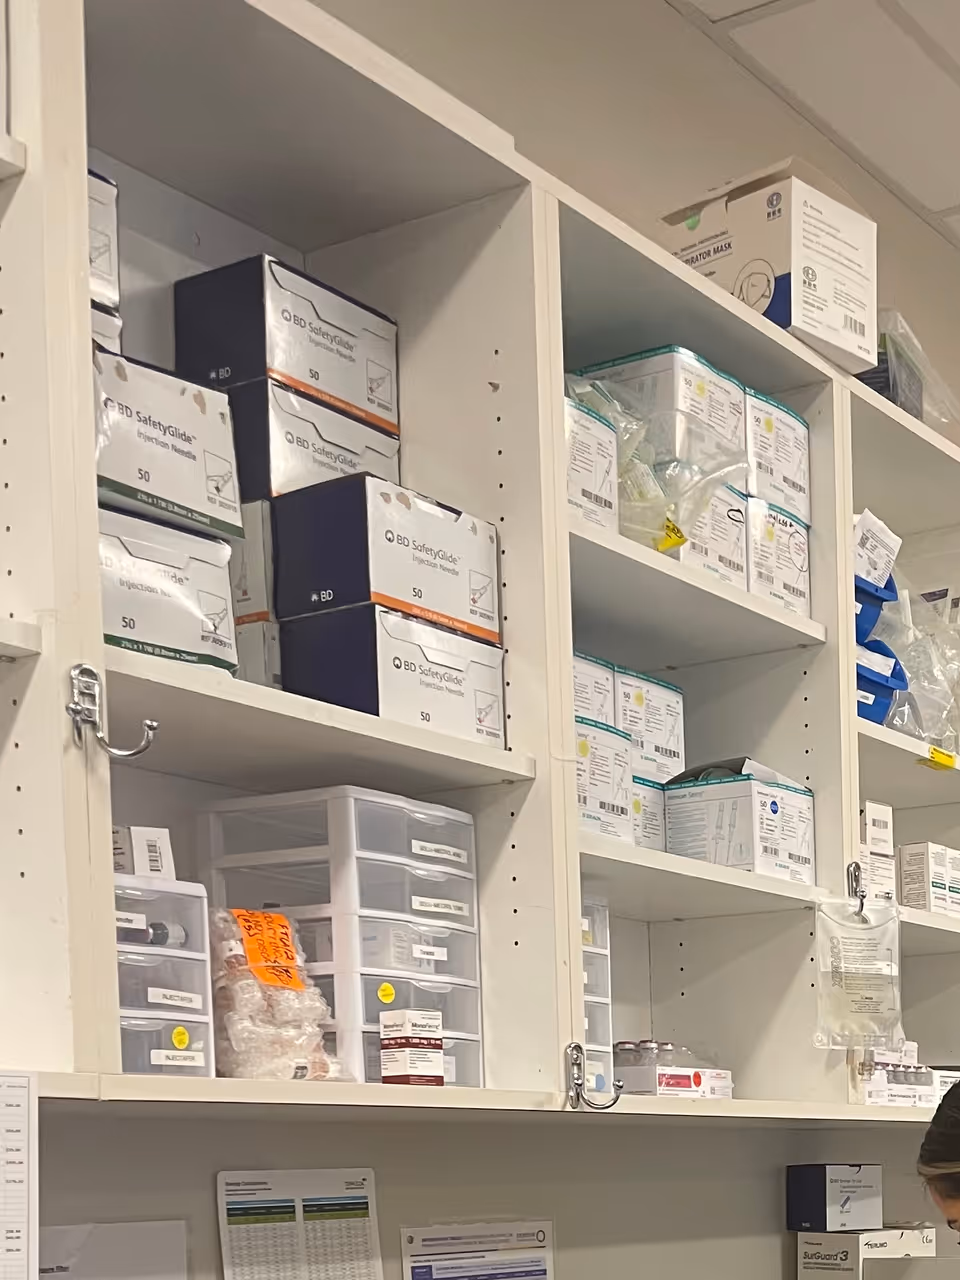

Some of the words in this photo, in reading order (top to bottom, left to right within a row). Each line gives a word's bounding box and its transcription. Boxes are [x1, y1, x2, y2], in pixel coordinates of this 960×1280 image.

[712, 241, 732, 256] MASK
[293, 314, 307, 329] BD
[218, 366, 231, 379] BD
[309, 368, 319, 381] 50
[117, 401, 133, 419] BD
[137, 467, 150, 483] 50
[396, 534, 410, 548] BD
[320, 589, 334, 602] BD
[412, 587, 423, 599] 50
[121, 616, 136, 630] 50
[403, 660, 417, 673] BD
[623, 691, 631, 700] 50
[420, 711, 431, 723] 50
[760, 800, 768, 809] 50
